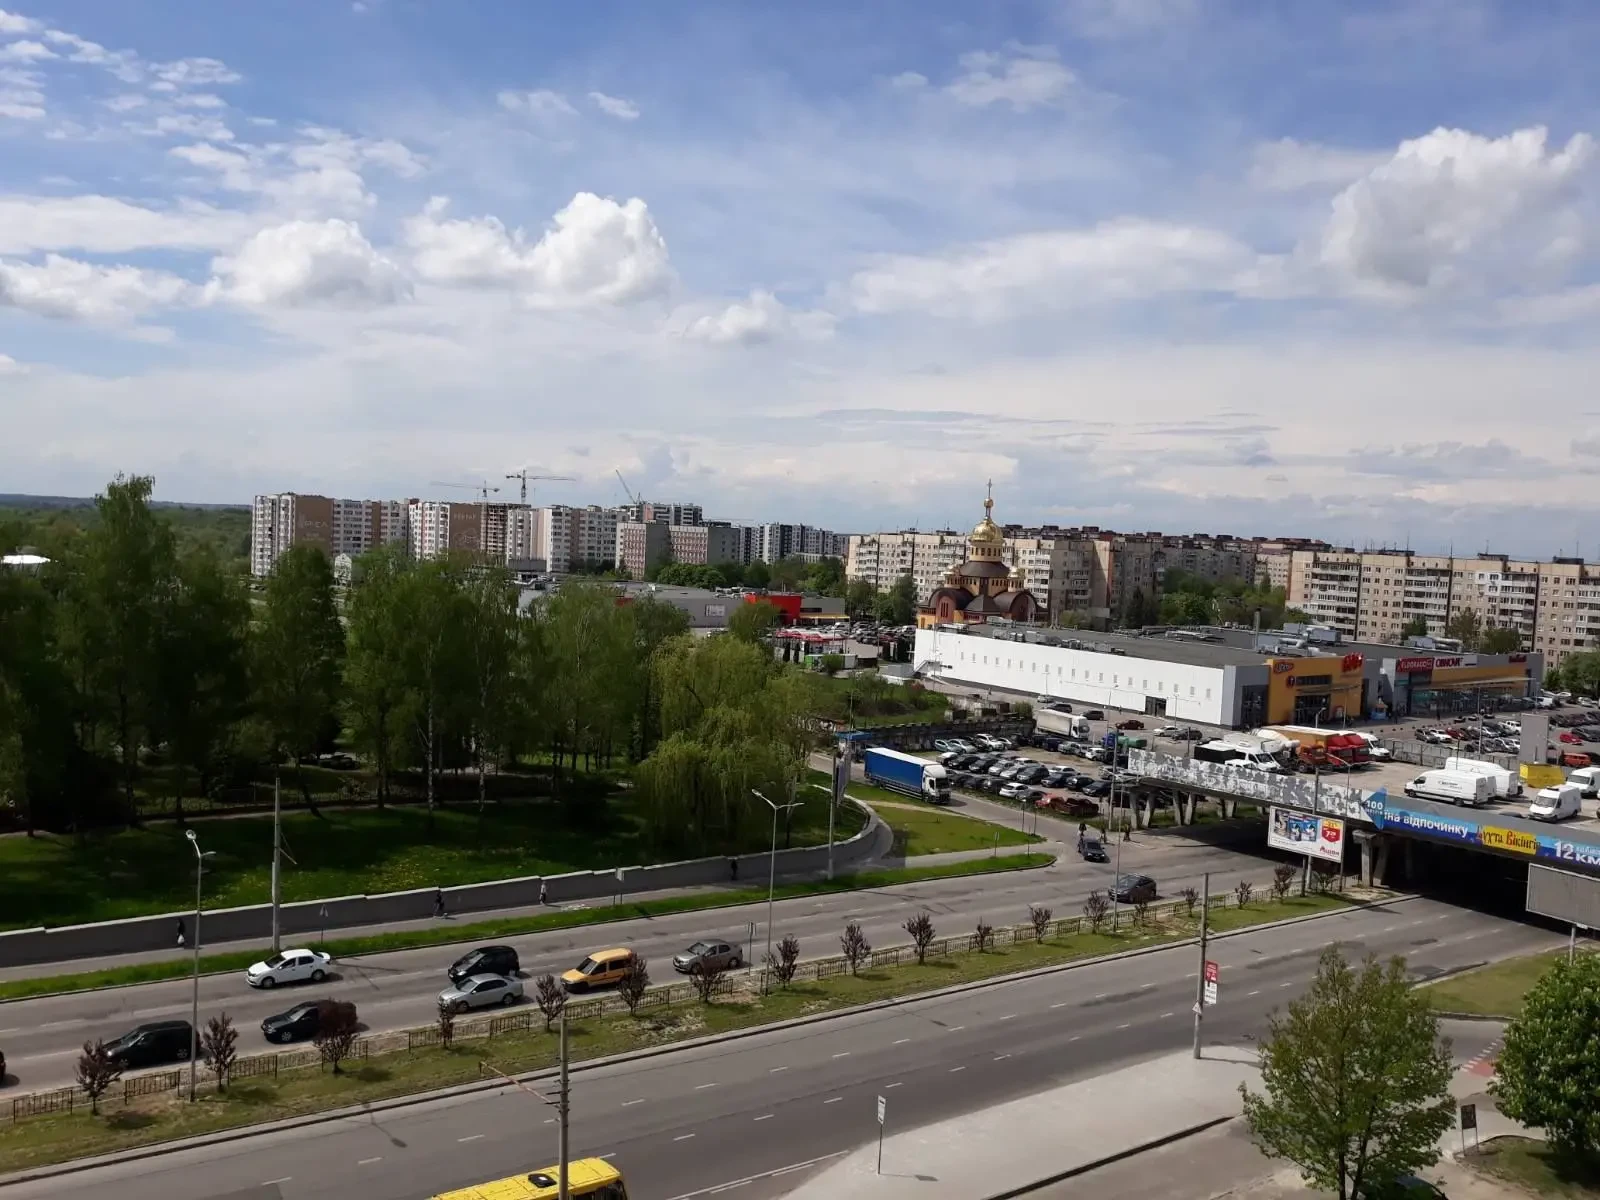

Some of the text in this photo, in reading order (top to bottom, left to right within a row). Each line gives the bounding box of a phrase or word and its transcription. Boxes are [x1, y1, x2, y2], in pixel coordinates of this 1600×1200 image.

[1366, 800, 1383, 810] 100
[1403, 815, 1469, 838] відпочинку
[1554, 840, 1575, 860] 12
